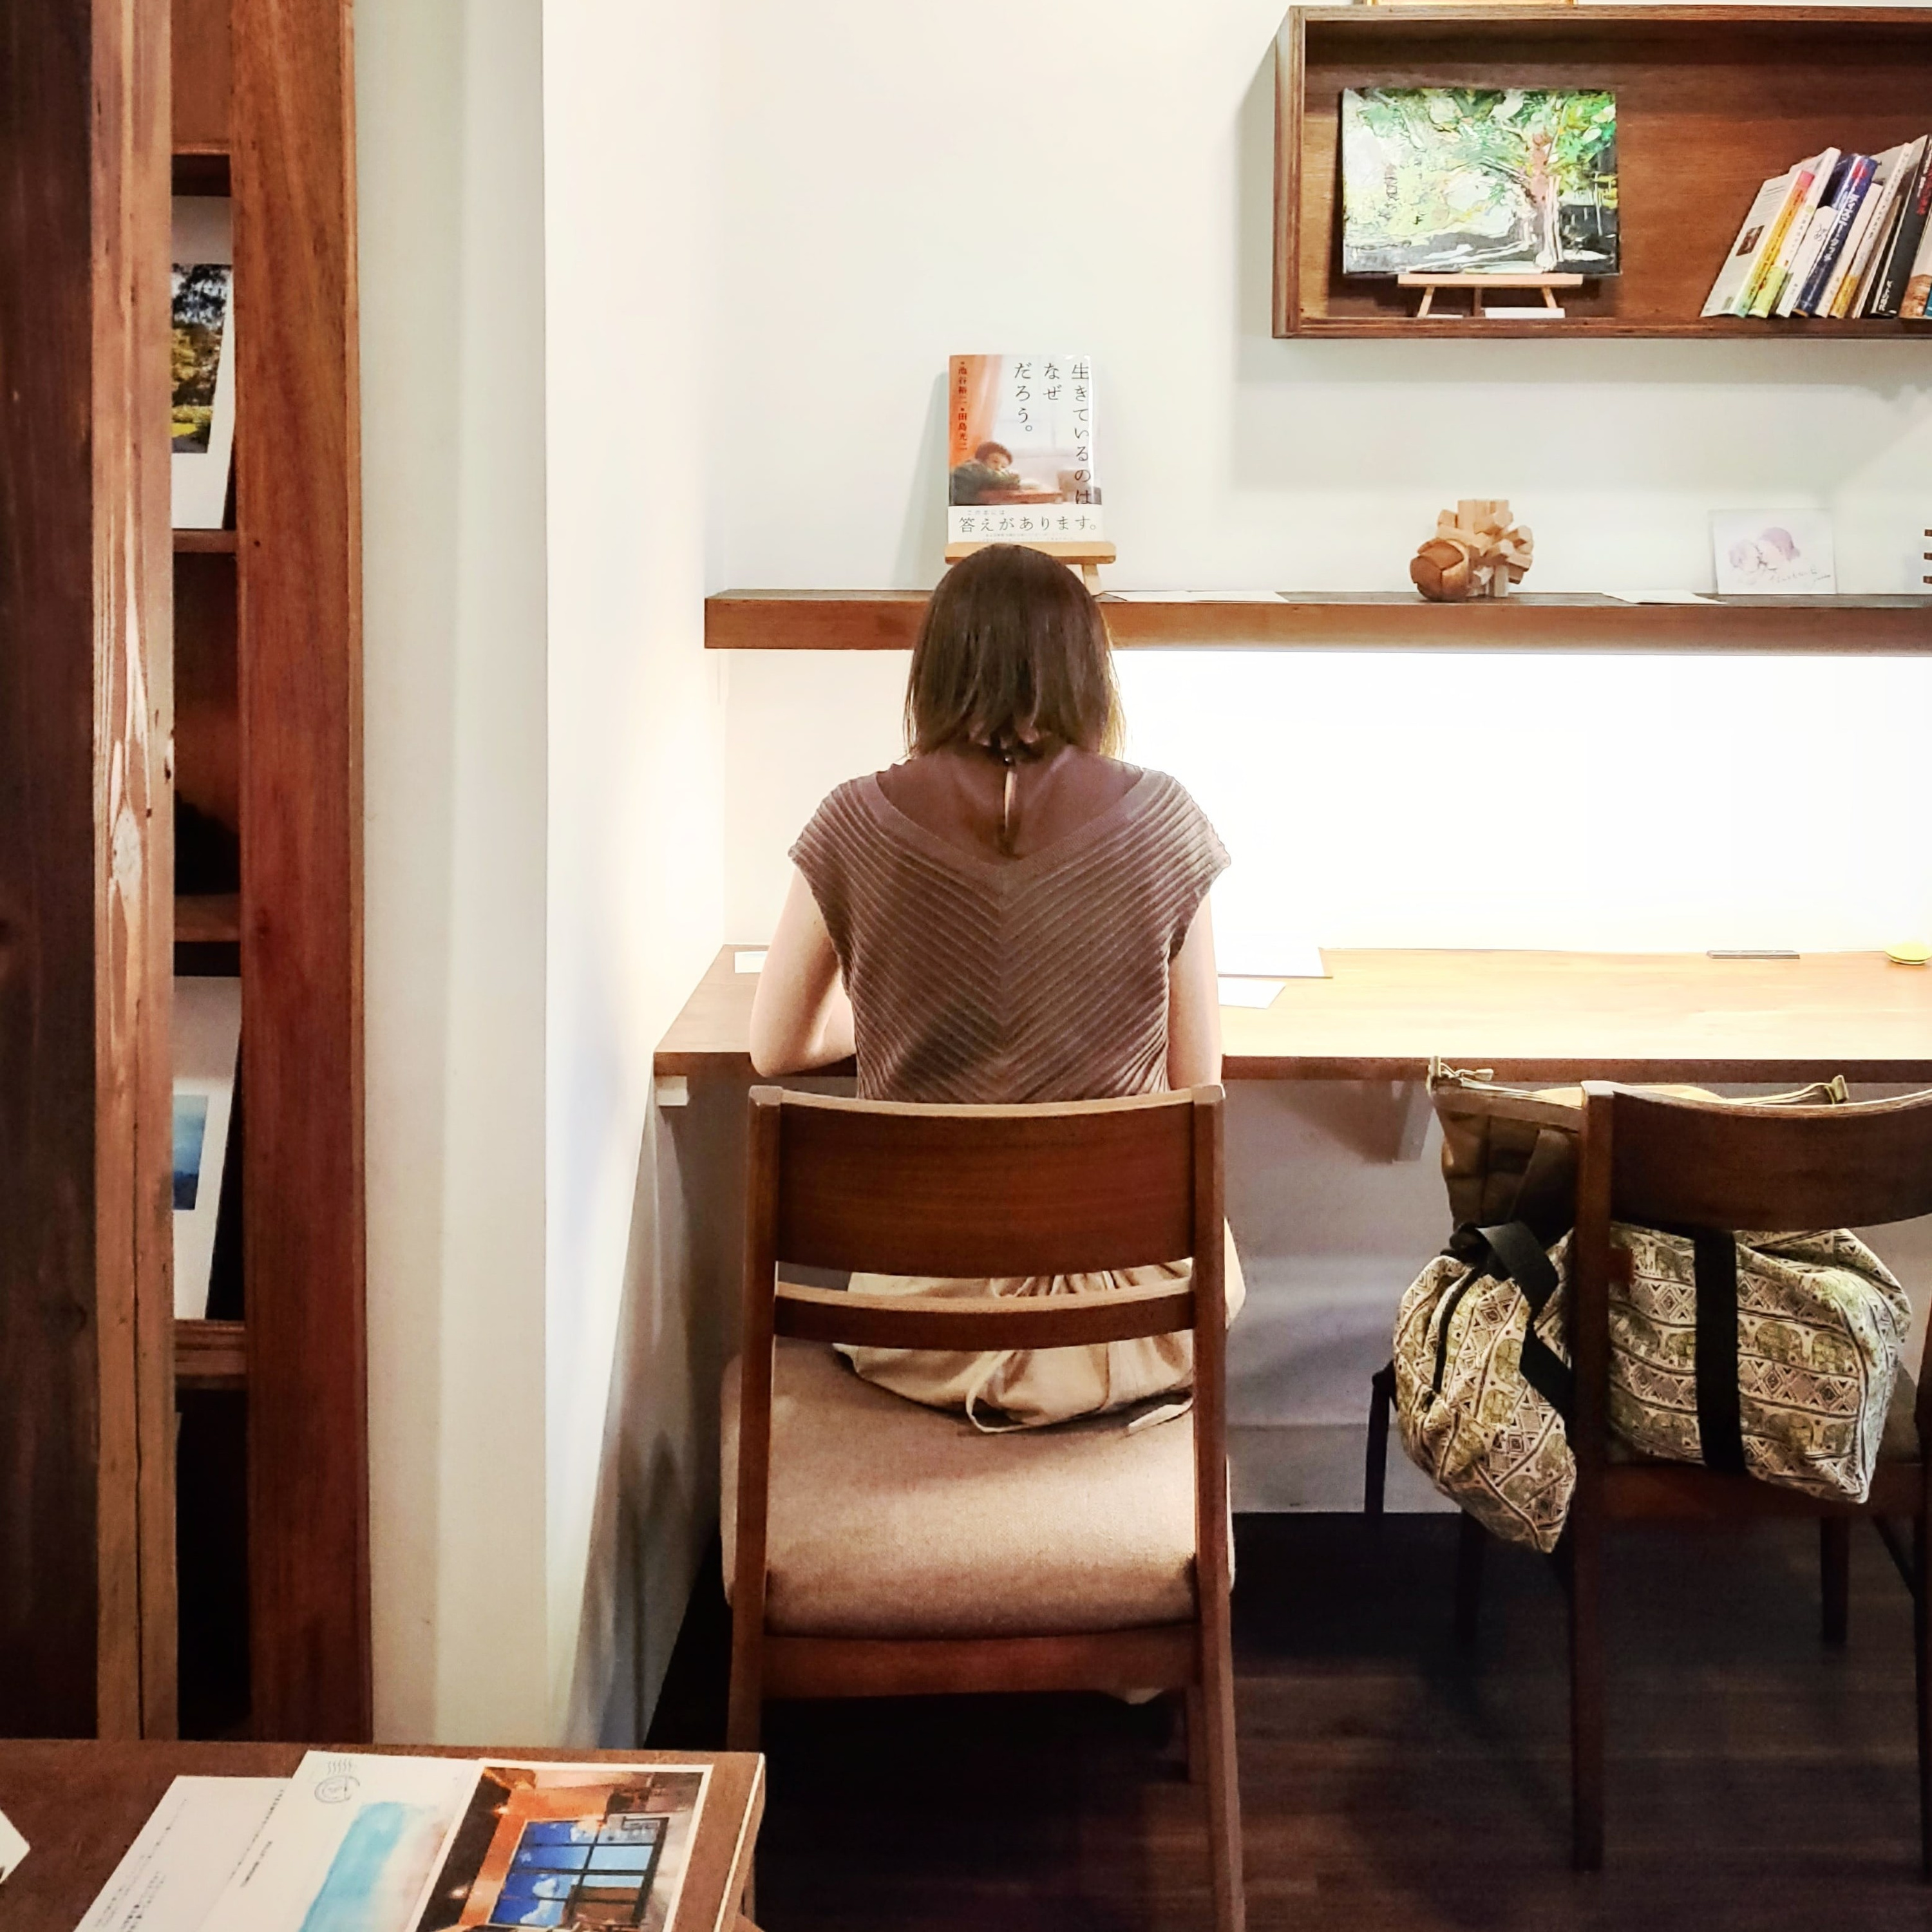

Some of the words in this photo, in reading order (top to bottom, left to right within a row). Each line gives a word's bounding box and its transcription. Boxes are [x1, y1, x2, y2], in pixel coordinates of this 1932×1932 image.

[1014, 362, 1032, 432] だろう。
[1043, 363, 1061, 401] なぜ
[1071, 362, 1091, 504] 生きているのは
[958, 515, 1097, 533] 答えがあります。
